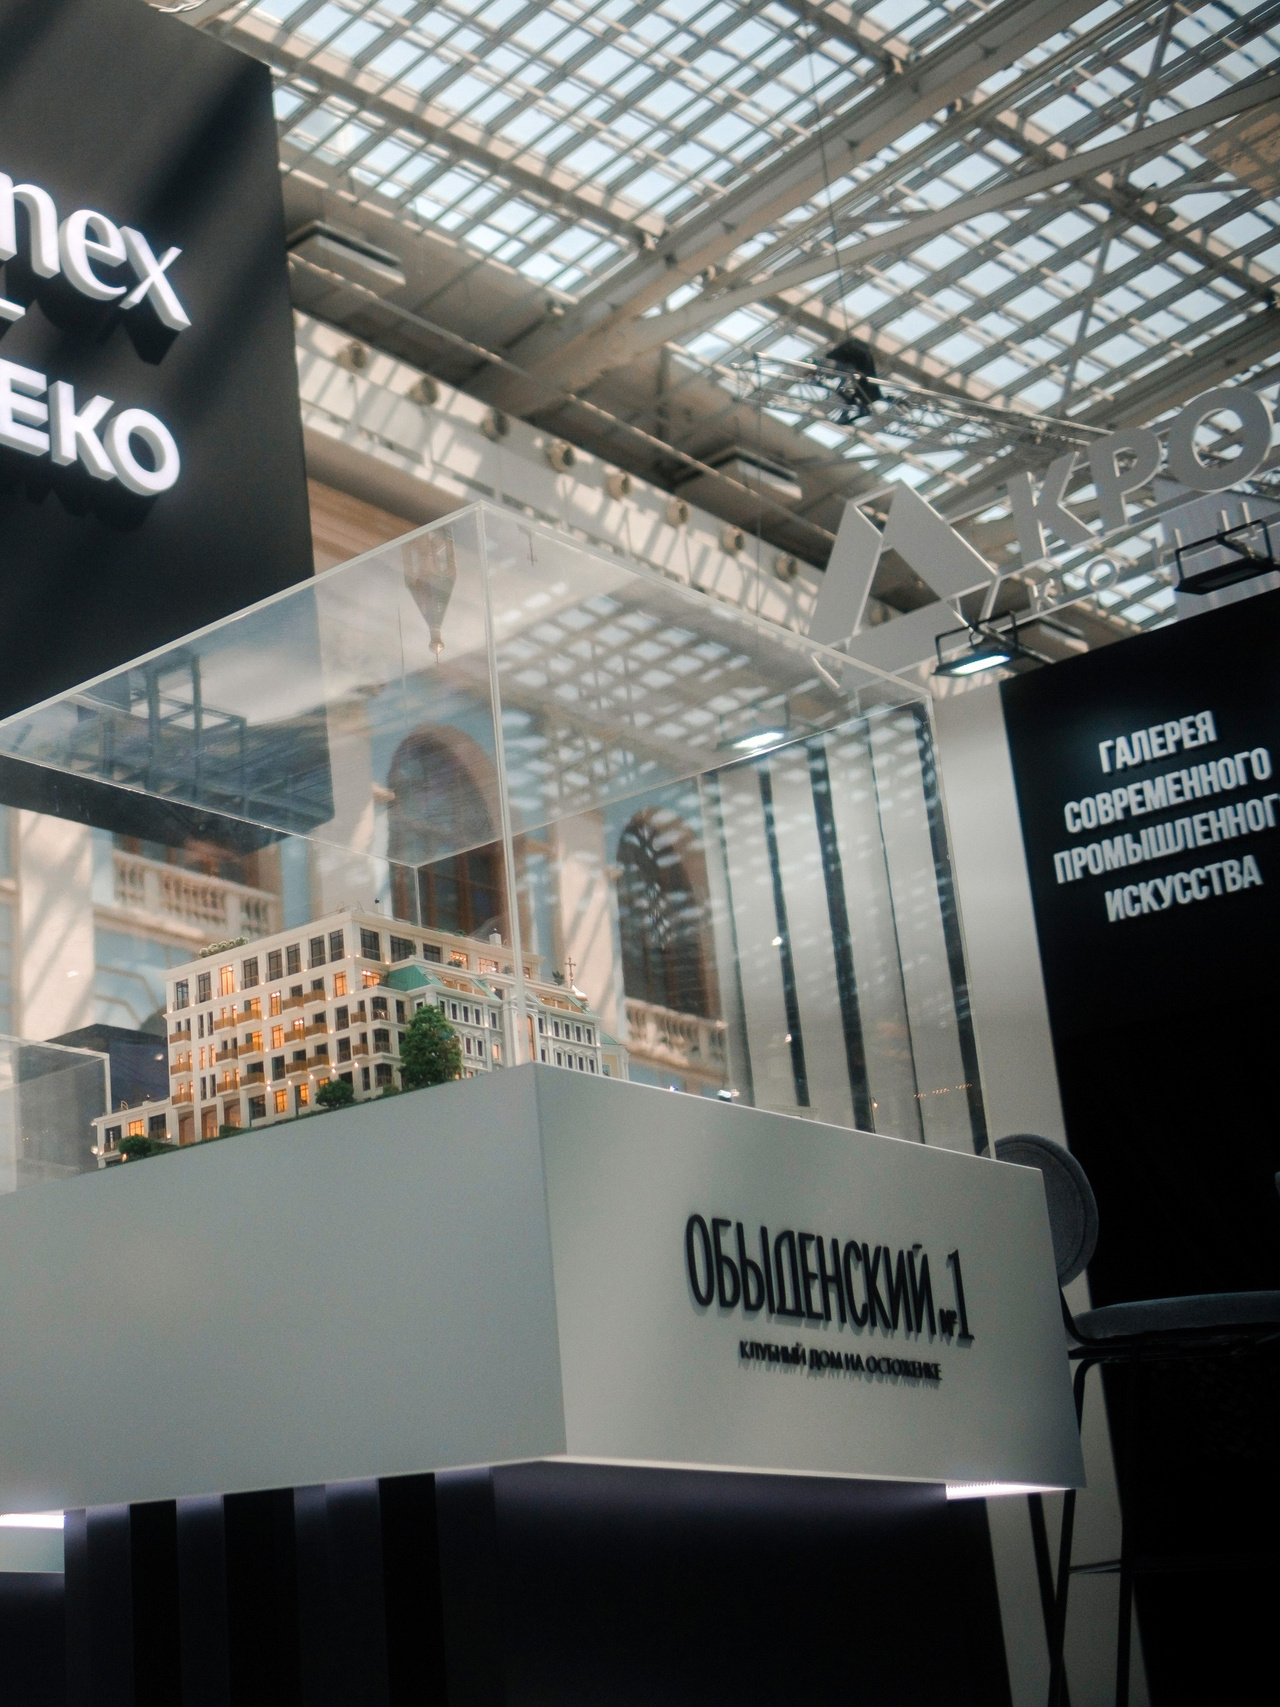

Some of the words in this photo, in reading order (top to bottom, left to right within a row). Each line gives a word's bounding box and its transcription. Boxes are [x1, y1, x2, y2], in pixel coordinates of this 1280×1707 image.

[1098, 710, 1218, 773] ГАЛЕРЕЯ
[1064, 747, 1272, 834] СОВРЕМЕННОГО
[1053, 793, 1280, 884] ПРОМЫШЛЕННОГ
[1104, 854, 1264, 922] ИСКУССТВА
[684, 1212, 937, 1336] ОБЫДЕНСКИЙ
[739, 1341, 807, 1366] КЛУБНЫЙ
[809, 1349, 844, 1370] ДОМ
[845, 1352, 865, 1372] НА
[865, 1356, 943, 1381] ОСТОЖЕНКЕ
